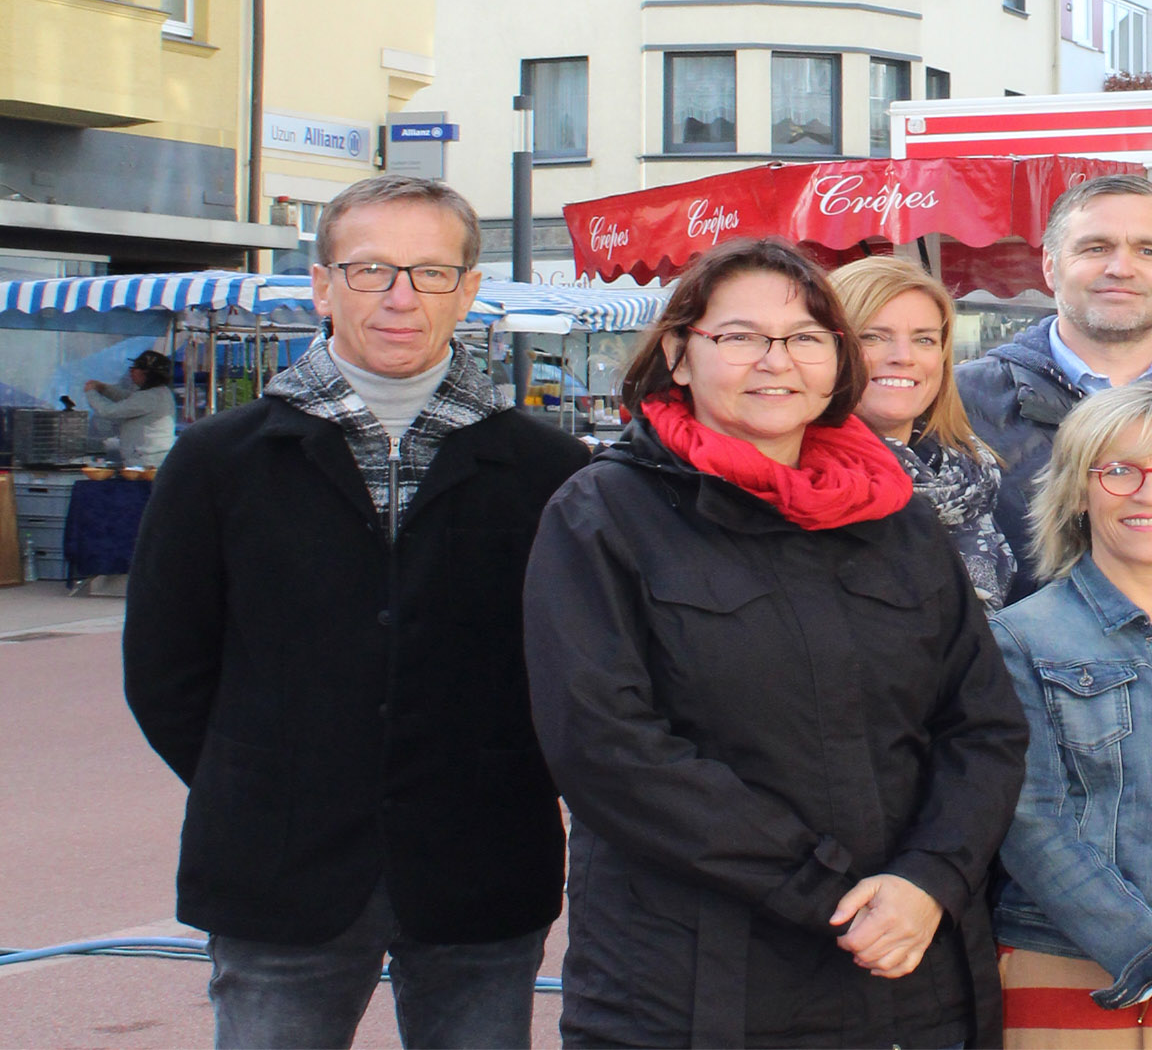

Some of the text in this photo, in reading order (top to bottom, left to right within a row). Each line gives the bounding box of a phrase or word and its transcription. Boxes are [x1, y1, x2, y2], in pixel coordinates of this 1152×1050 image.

[272, 125, 345, 149] Uzun Allianz
[815, 175, 938, 225] Crêpes
[589, 216, 629, 260] Crêpes
[688, 200, 739, 245] Crêpes
